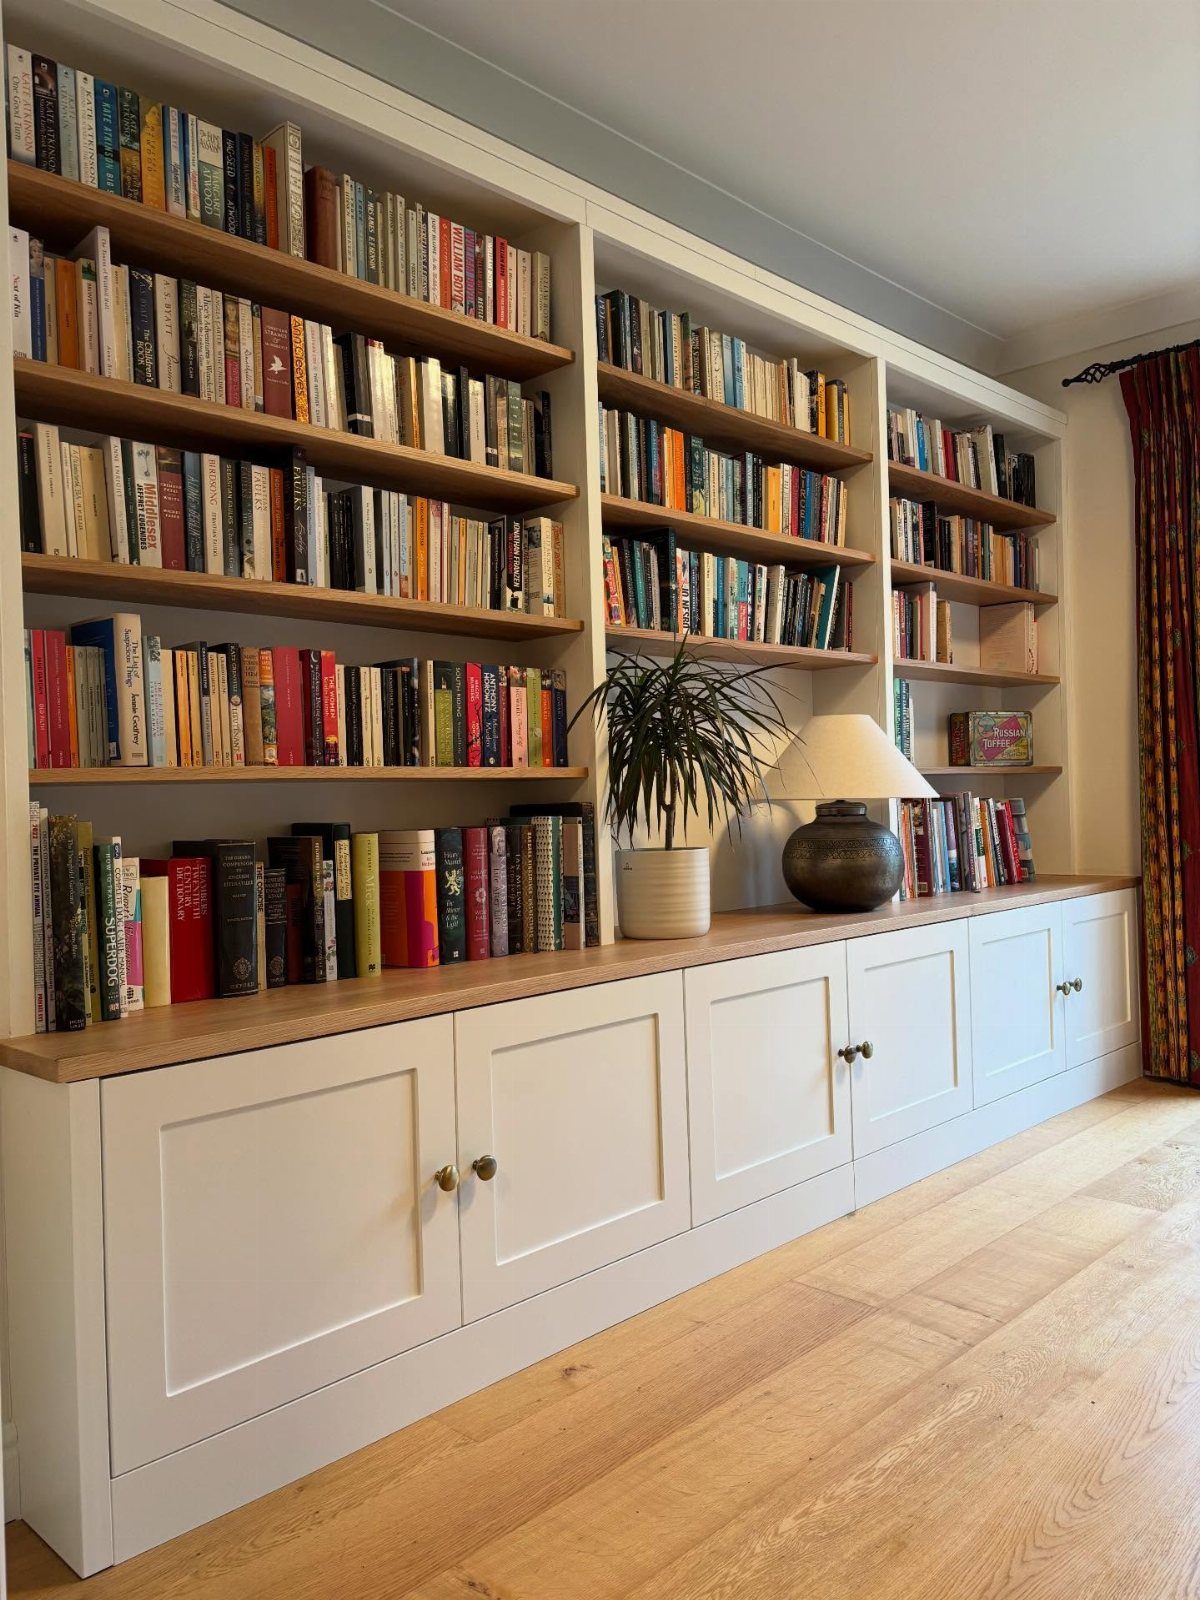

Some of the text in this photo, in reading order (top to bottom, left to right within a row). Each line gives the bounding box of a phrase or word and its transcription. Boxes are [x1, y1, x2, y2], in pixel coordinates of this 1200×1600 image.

[12, 75, 22, 140] One Good Turn
[21, 71, 34, 154] KATE ATKINSON
[123, 102, 131, 144] ATKINSON
[46, 100, 57, 173] KATE ATKINSON
[86, 90, 97, 185] KATE ATKINSON
[102, 101, 114, 186] KATE ATKINSON BIG
[226, 138, 236, 178] HAG-SEED
[203, 166, 213, 215] ATWOOD
[212, 169, 221, 218] MARGARET
[227, 199, 236, 234] ATWOOD
[13, 274, 21, 293] Next
[452, 226, 464, 303] WILLIAM BOYD
[466, 232, 475, 302] WILLIAM BOYD
[14, 294, 21, 304] of
[164, 303, 173, 337] BYATT
[203, 292, 211, 319] Alice's
[136, 340, 145, 365] BOOK
[204, 319, 212, 359] Adventures
[292, 318, 304, 396] Ann Cleeves
[144, 341, 154, 383] Children's
[208, 459, 218, 506] BIRDSONG
[254, 471, 263, 511] FAULKS
[293, 466, 302, 511] FAULKS
[137, 483, 147, 550] JEFFREY EUGENIDES
[144, 482, 158, 550] Middlesex
[188, 474, 201, 536] ALONE BERLIN
[682, 587, 690, 597] JO
[122, 627, 134, 687] Suspicious Things
[131, 640, 139, 655] The
[133, 670, 141, 678] of
[489, 673, 497, 713] ANTHONY
[130, 692, 142, 745] Jennie Godfrey
[329, 691, 337, 718] WOMEN
[982, 738, 1011, 750] TOFFEE
[993, 726, 1026, 739] RUSSIAN
[33, 856, 41, 881] PRIVATE
[105, 873, 112, 883] TO
[184, 866, 193, 908] CENTURY
[199, 864, 208, 916] CHAMBERS
[176, 867, 186, 922] DICTIONARY
[192, 863, 201, 920] TWENTIETH
[256, 881, 264, 913] CONCISE
[114, 867, 127, 988] COMPLETE DOG CARE MANUAL
[104, 917, 119, 986] SUPERDOG
